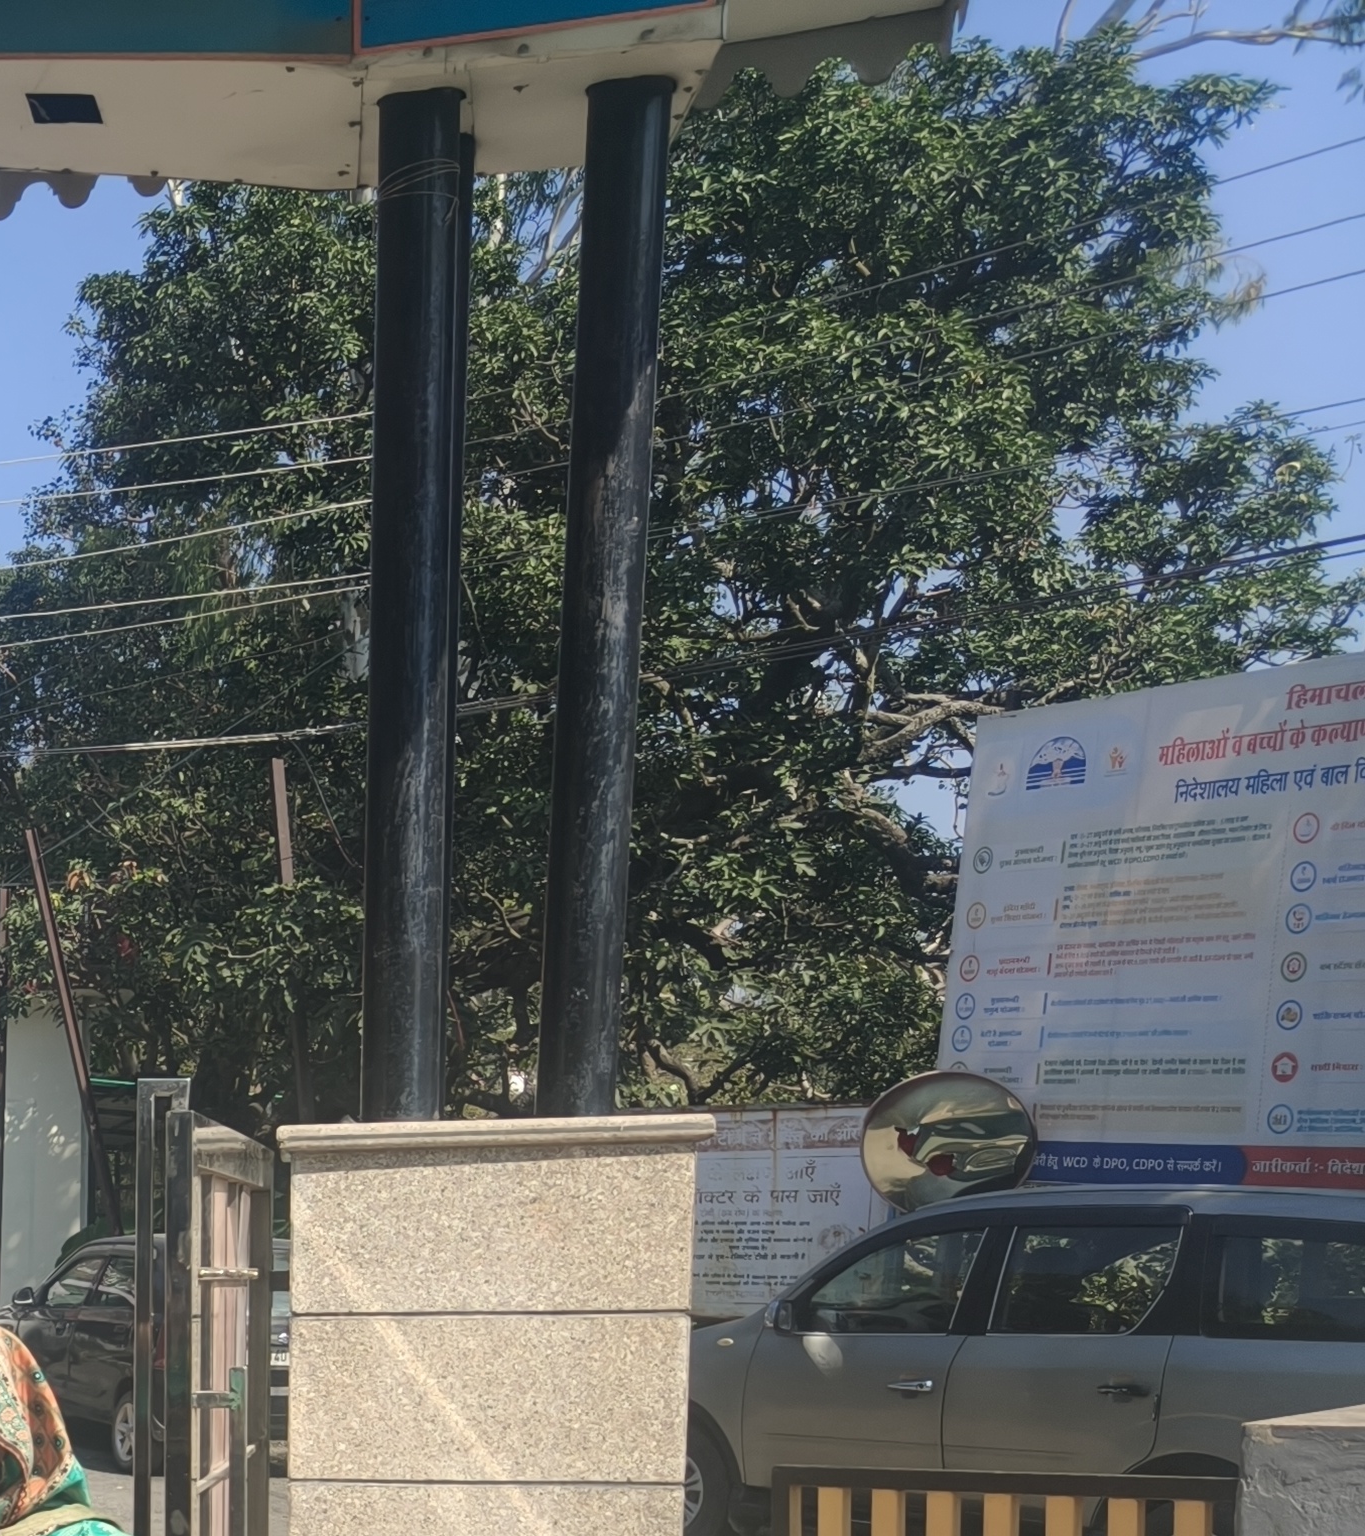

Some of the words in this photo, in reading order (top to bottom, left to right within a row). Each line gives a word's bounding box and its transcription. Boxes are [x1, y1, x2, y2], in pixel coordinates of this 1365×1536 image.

[1159, 727, 1230, 766] महिलाओं
[1246, 719, 1288, 755] बच्चों
[1288, 719, 1309, 749] के
[1174, 776, 1241, 803] निदेशालय
[1245, 768, 1289, 795] महिला
[1293, 764, 1317, 791] एवं
[1320, 764, 1351, 787] बाल
[1063, 1156, 1088, 1168] WCD
[1093, 1155, 1101, 1168] के
[1103, 1157, 1130, 1172] DPO,
[1132, 1158, 1164, 1171] CDPO
[1165, 1157, 1176, 1172] से
[1252, 1157, 1311, 1174] जारीकर्ता
[743, 1184, 762, 1204] के
[770, 1188, 800, 1204] पास
[806, 1182, 843, 1207] जाएँ
